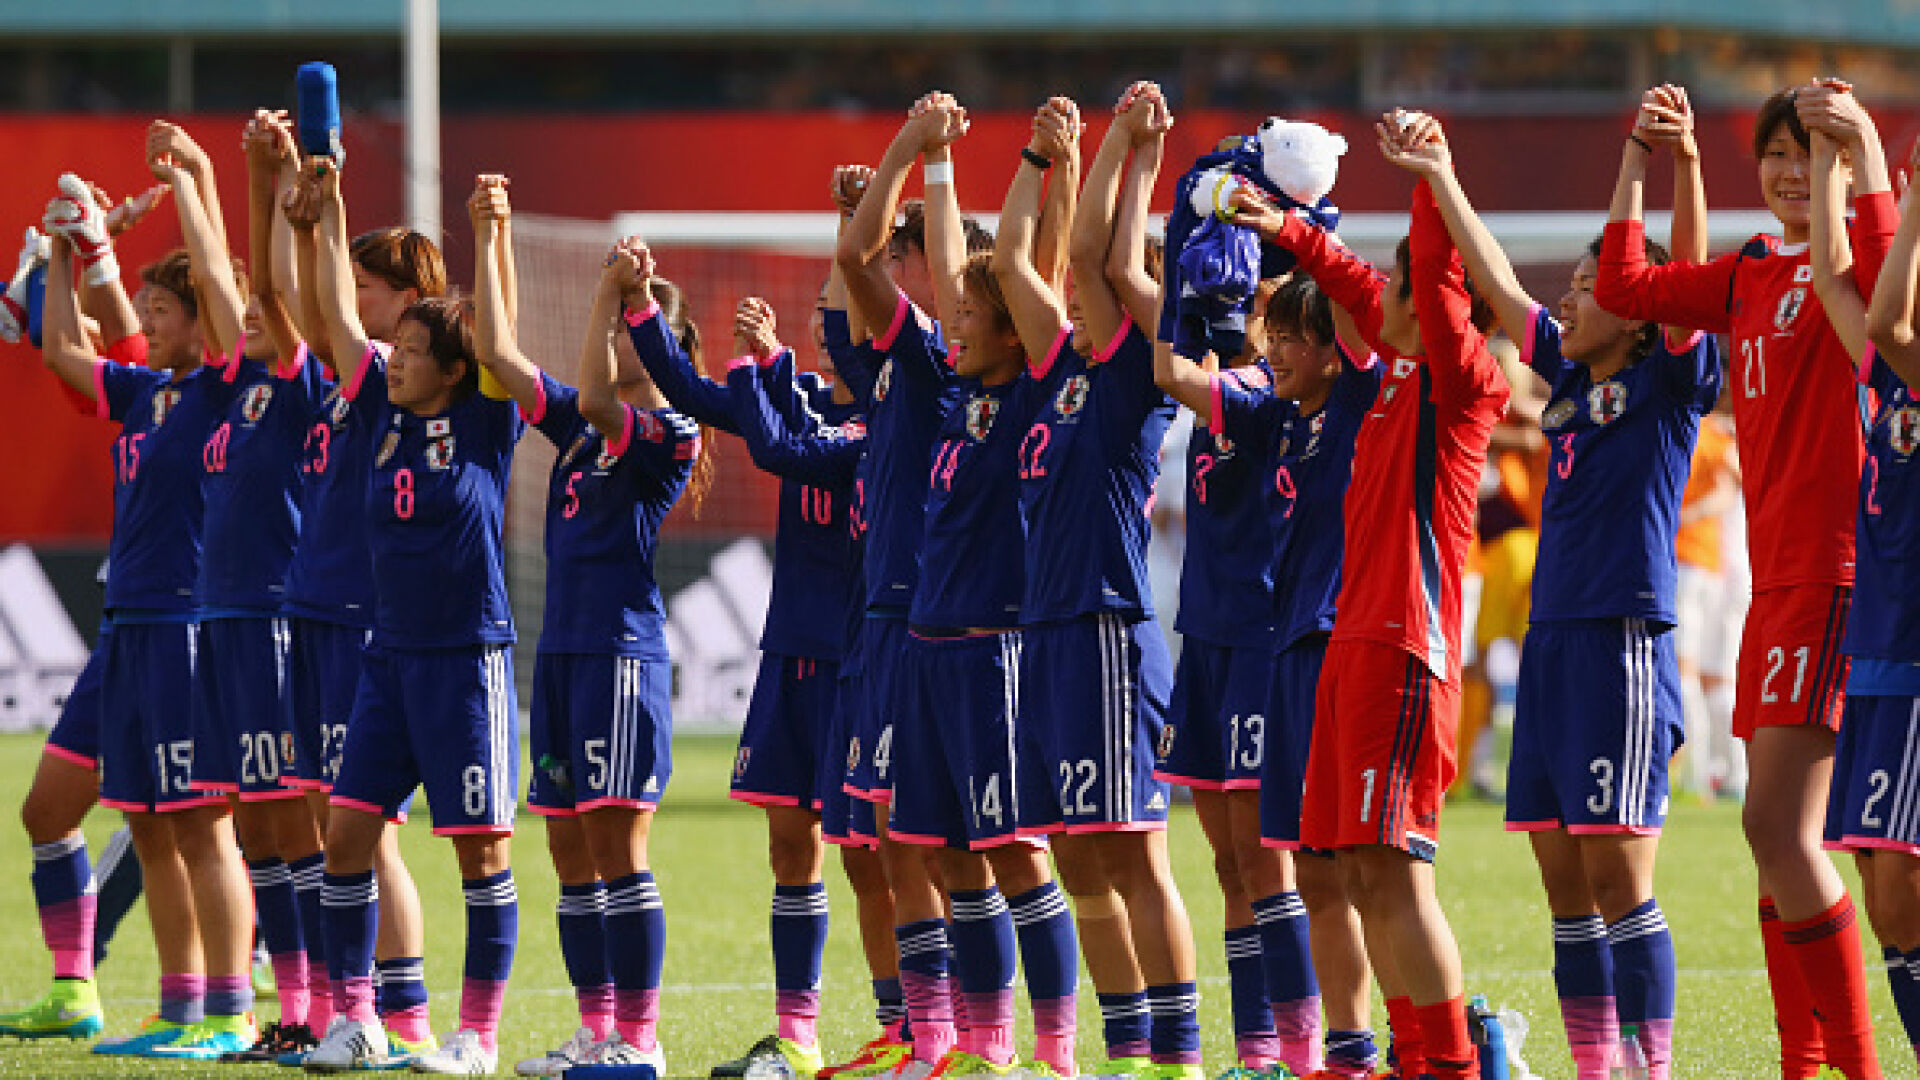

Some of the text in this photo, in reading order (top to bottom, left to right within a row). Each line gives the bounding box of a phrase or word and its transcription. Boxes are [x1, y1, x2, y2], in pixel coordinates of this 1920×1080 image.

[1742, 335, 1767, 399] 21
[118, 432, 146, 486] 15
[1557, 432, 1576, 480] 3
[394, 468, 414, 519] 8
[562, 471, 583, 519] 5
[1276, 465, 1297, 518] 9
[1866, 455, 1882, 514] 2
[1761, 646, 1811, 703] 21
[155, 738, 194, 796] 15
[239, 731, 279, 784] 20
[584, 739, 609, 790] 5
[1228, 714, 1265, 770] 13
[462, 766, 486, 816] 8
[968, 772, 1003, 829] 14
[1059, 758, 1099, 816] 22
[1360, 768, 1377, 823] 1
[1586, 757, 1614, 815] 3
[1861, 769, 1890, 828] 2
